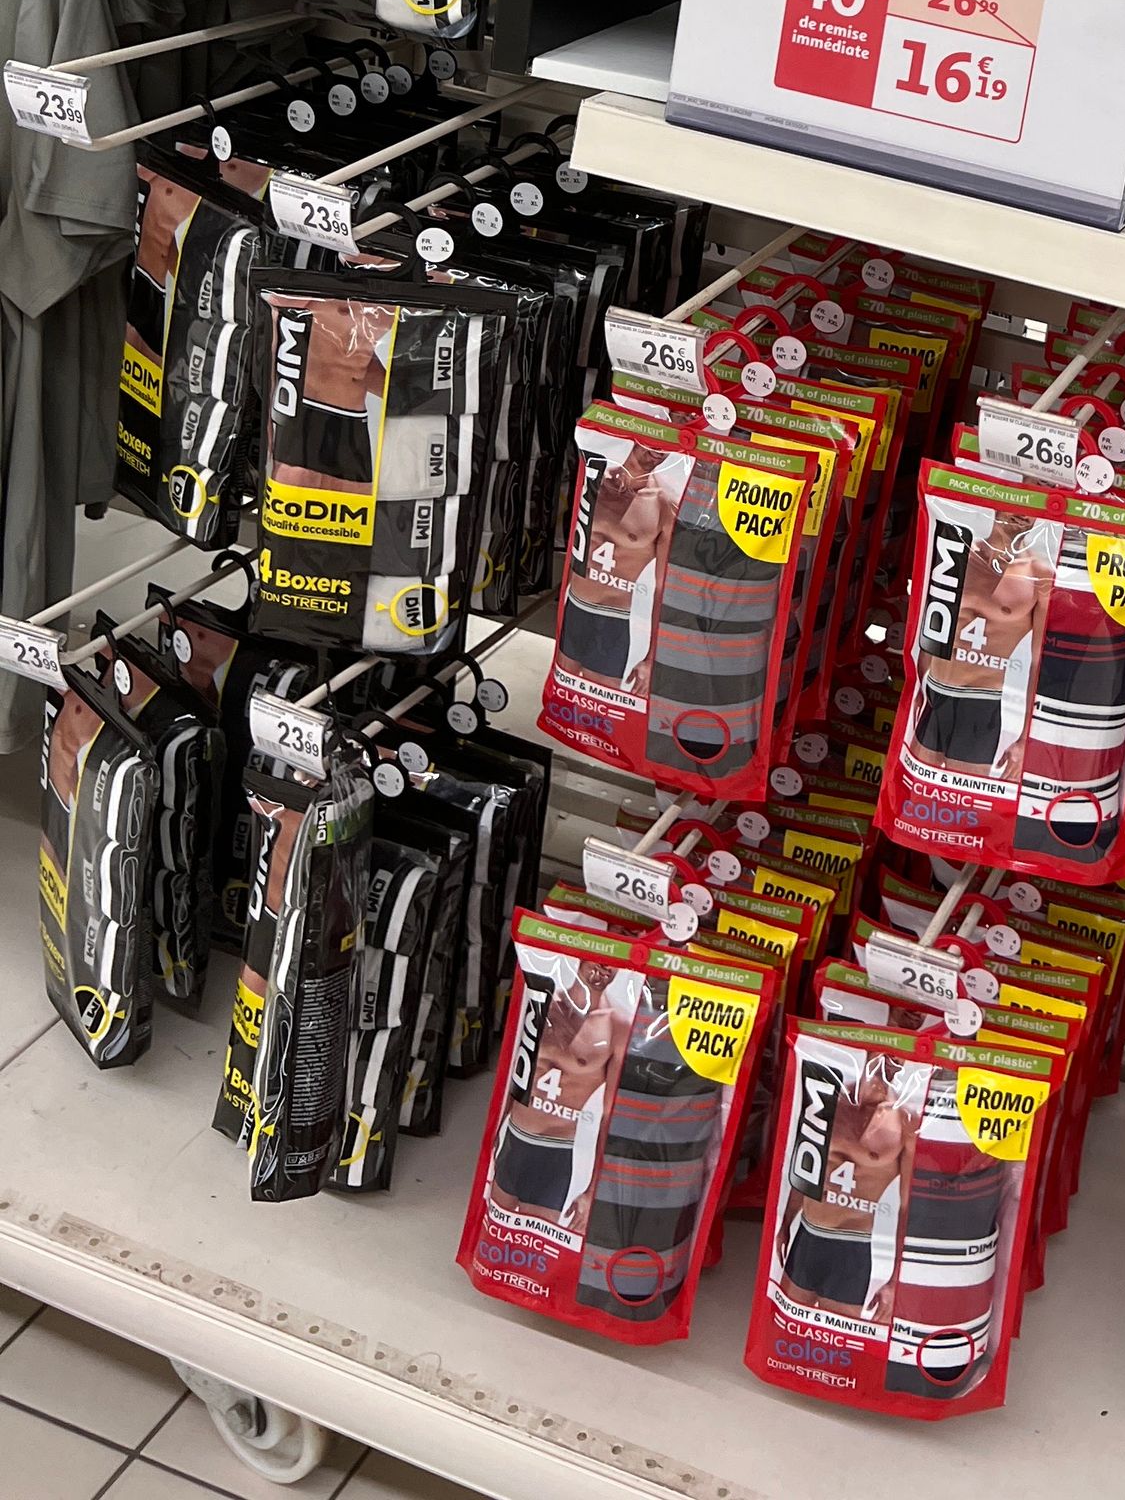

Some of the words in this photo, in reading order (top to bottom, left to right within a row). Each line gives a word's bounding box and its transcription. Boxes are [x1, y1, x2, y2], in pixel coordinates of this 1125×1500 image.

[799, 16, 817, 30] de
[819, 21, 868, 42] remise
[791, 32, 870, 60] immédiate
[302, 523, 361, 540] accessible
[275, 568, 351, 595] Boxers
[923, 538, 965, 644] DIM
[913, 783, 972, 808] CLASSIC
[941, 775, 948, 783] &
[952, 776, 1006, 796] MAINTIEN
[902, 799, 978, 826] colors
[676, 994, 745, 1030] PROMO
